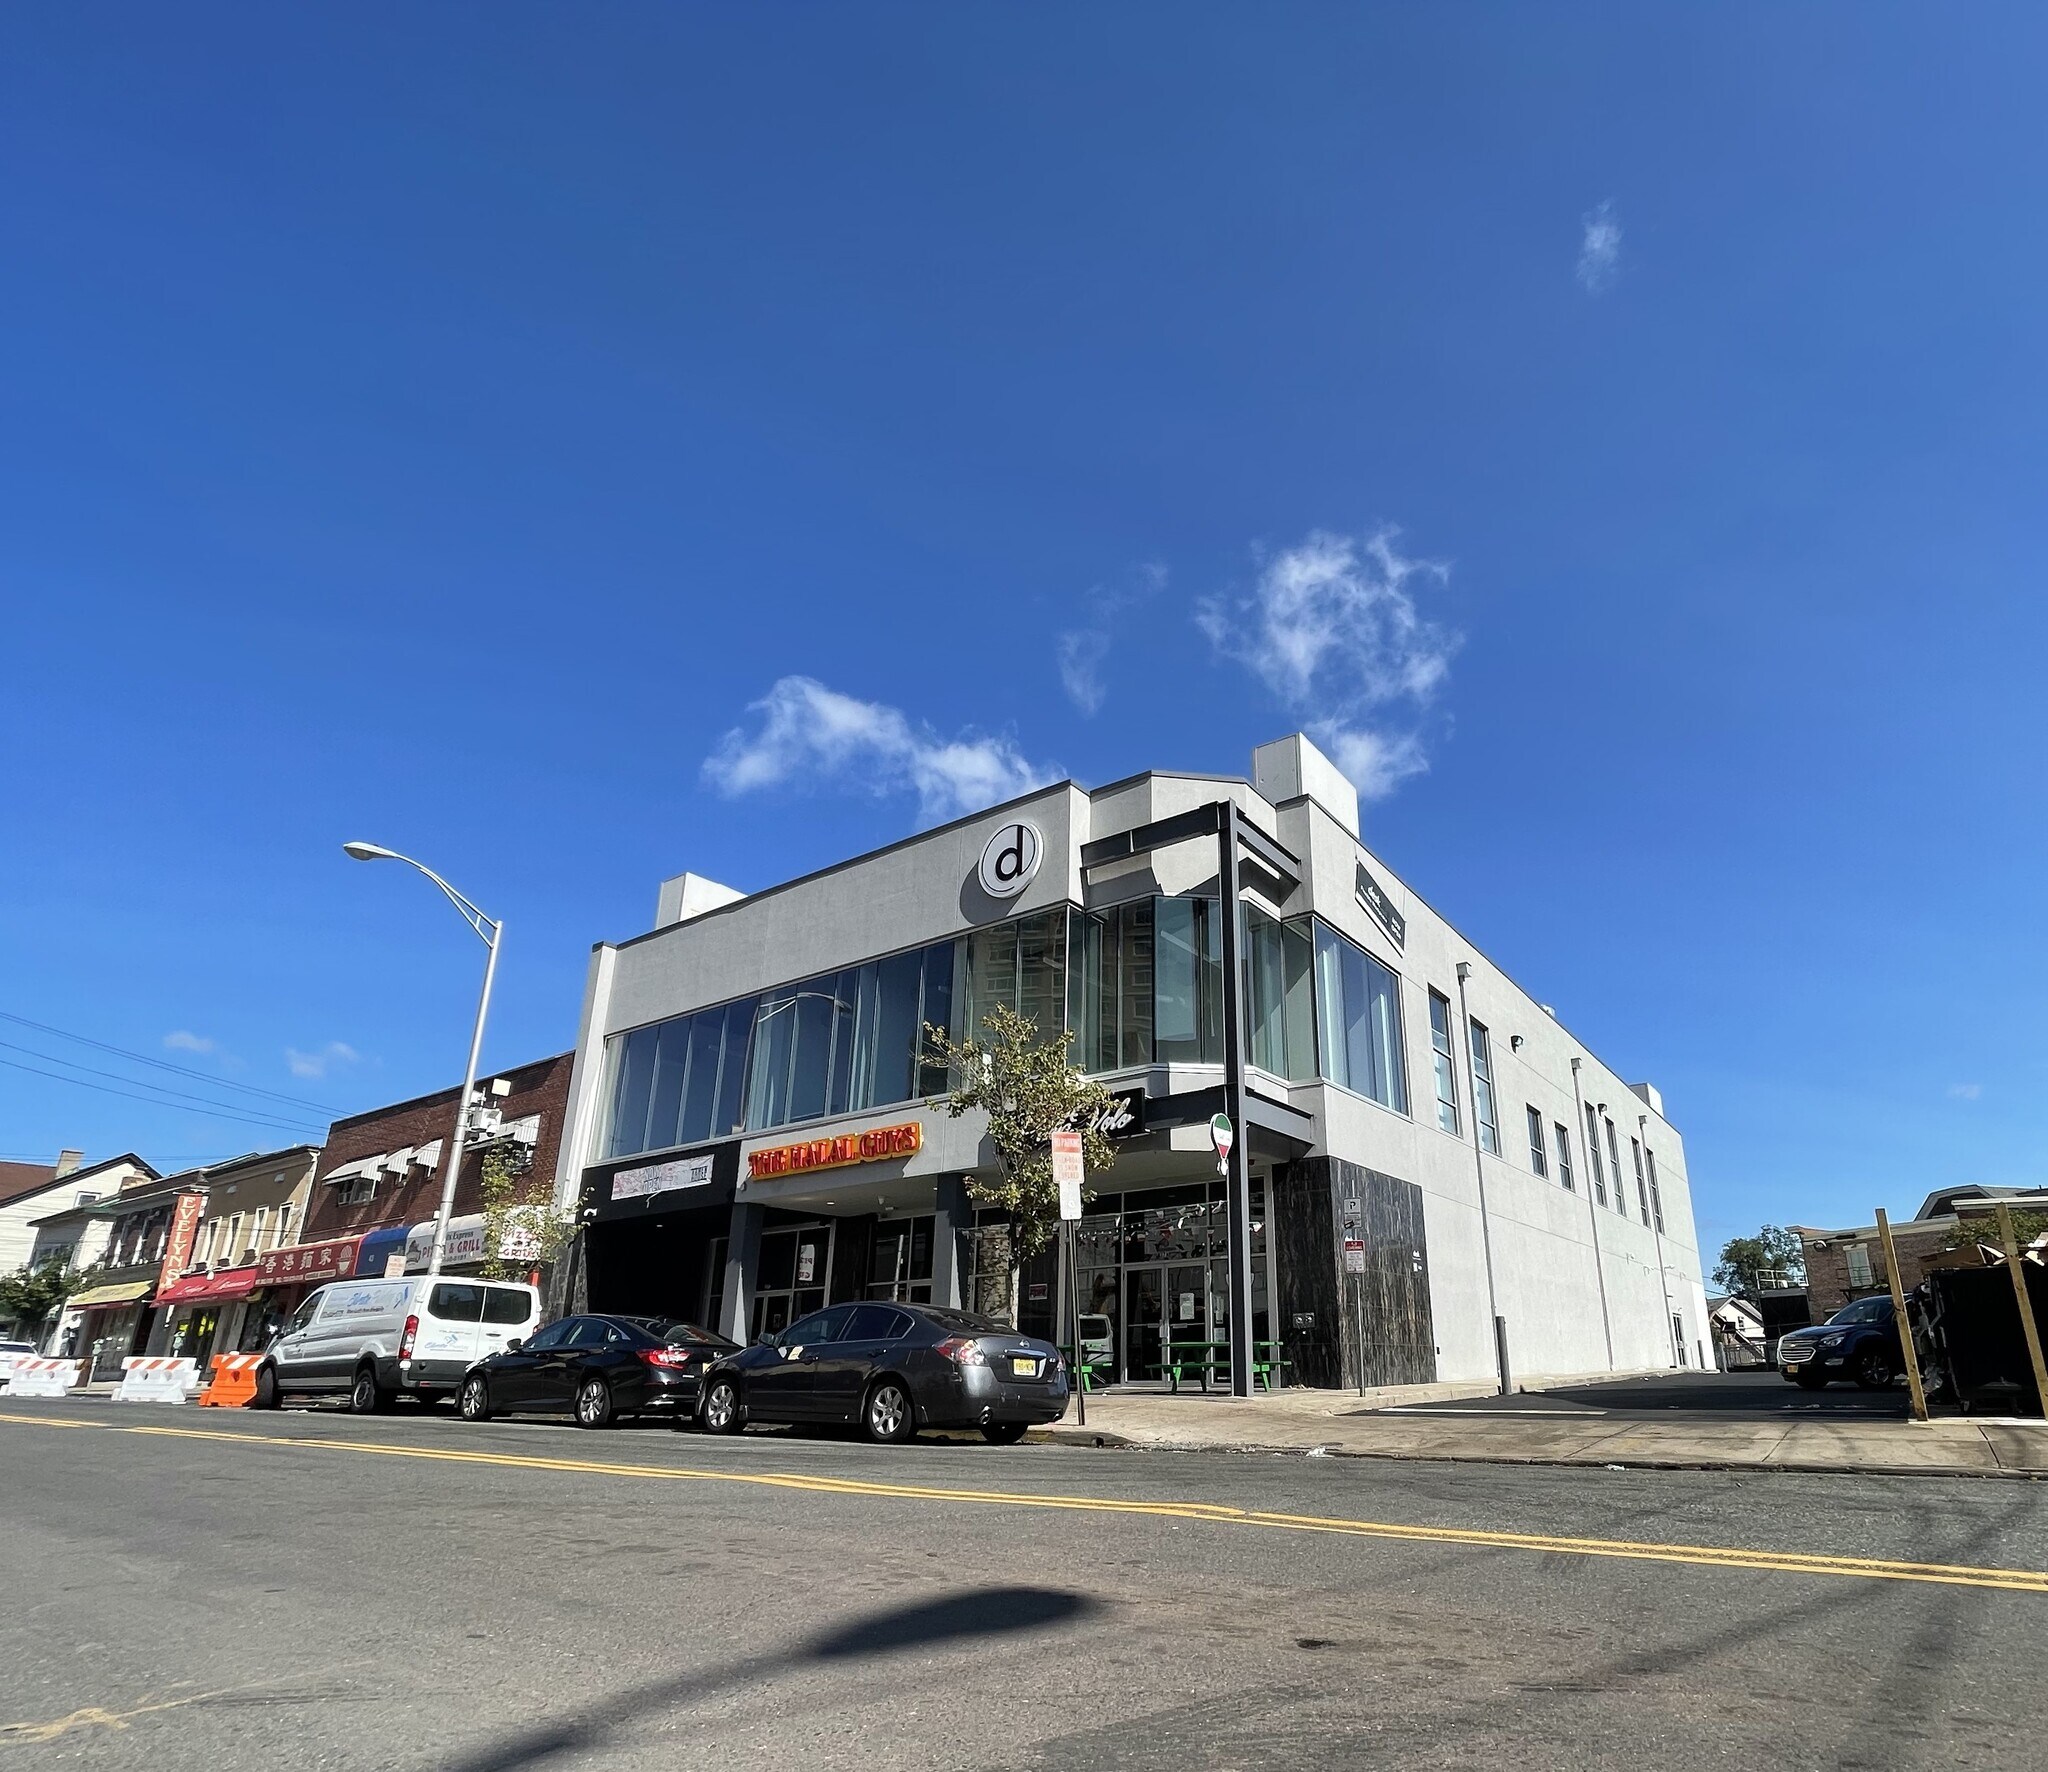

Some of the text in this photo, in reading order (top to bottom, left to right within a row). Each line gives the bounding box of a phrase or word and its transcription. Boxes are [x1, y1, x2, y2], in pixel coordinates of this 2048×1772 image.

[748, 1126, 917, 1177] THE HALAL GUYS
[457, 1238, 480, 1253] GRILL
